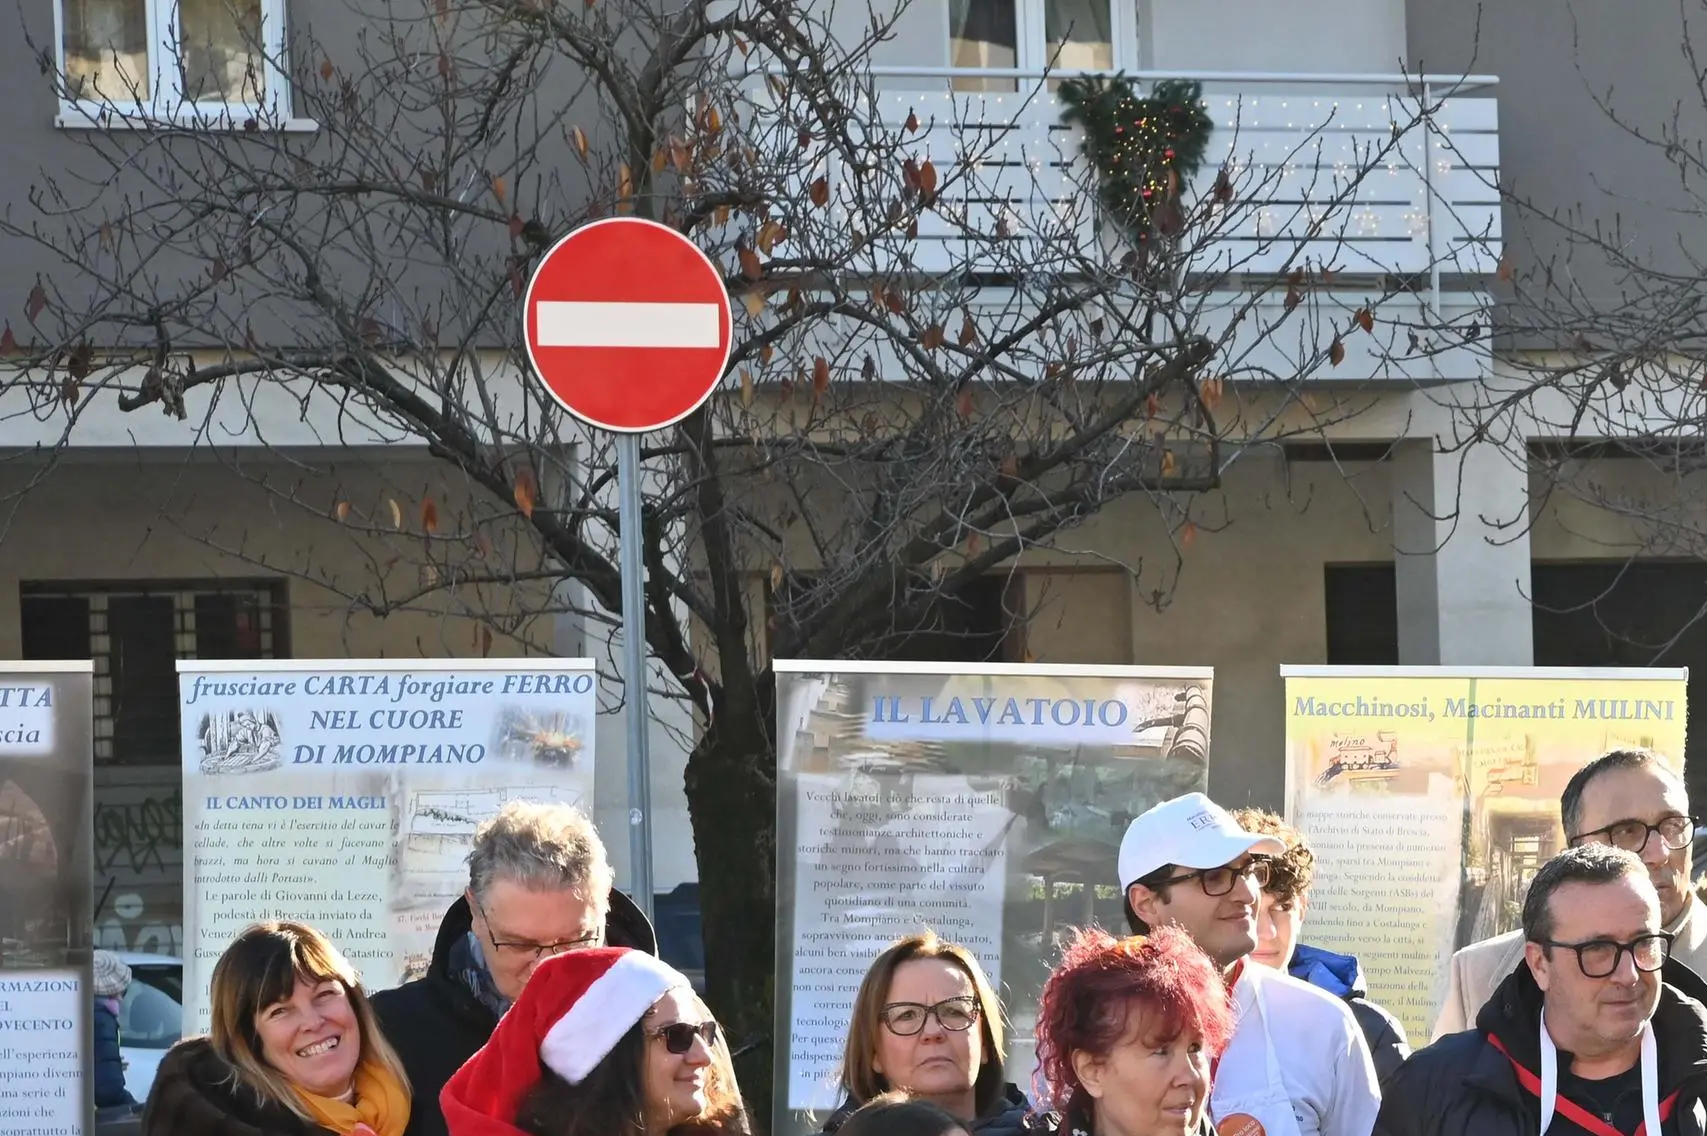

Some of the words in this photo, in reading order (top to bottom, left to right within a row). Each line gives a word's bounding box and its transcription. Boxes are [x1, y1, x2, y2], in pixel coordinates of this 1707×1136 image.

[186, 676, 296, 704] frusciare
[304, 676, 390, 696] CARTA
[391, 676, 493, 704] forgiare
[501, 675, 593, 695] FERRO
[872, 695, 909, 723] IL
[920, 696, 1128, 727] LAVATOIO
[1293, 696, 1435, 721] Macchinosi,
[1442, 697, 1565, 719] Macinanti
[1572, 699, 1674, 721] MULINI
[310, 709, 362, 730] NEL
[369, 709, 464, 730] CUORE
[292, 744, 325, 765] DI
[332, 743, 486, 765] MOMPIANO
[206, 796, 222, 809] IL
[226, 796, 288, 810] CANTO
[292, 796, 323, 810] DEI
[328, 796, 387, 810] MAGLI
[913, 812, 973, 822] considerate
[341, 819, 356, 831] del
[894, 829, 973, 840] architettoniche
[236, 838, 254, 849] che
[261, 838, 286, 849] altre
[293, 838, 319, 849] volte
[338, 837, 385, 852] facevano
[302, 857, 338, 866] cavano
[362, 854, 399, 869] Maglio
[864, 861, 918, 873] fortissimo
[948, 864, 985, 875] cultura
[813, 879, 864, 892] popolare,
[867, 882, 896, 891] come
[899, 881, 926, 893] parte
[929, 879, 946, 891] del
[949, 880, 985, 892] vissuto
[205, 889, 216, 901] Le
[221, 890, 257, 904] parole
[260, 889, 272, 901] di
[275, 889, 327, 902] Giovanni
[330, 889, 344, 902] da
[347, 890, 383, 903] Lezze,
[824, 896, 882, 909] quotidiano
[884, 897, 895, 907] di
[213, 909, 256, 924] podestà
[259, 909, 271, 921] di
[274, 909, 315, 921] Brescia
[318, 910, 357, 921] inviato
[359, 910, 373, 921] da
[821, 913, 841, 924] Tra
[843, 913, 901, 928] Mompiano
[346, 927, 387, 940] Andrea
[801, 931, 872, 944] sopravvivono
[342, 948, 395, 960] Catastico
[827, 947, 847, 959] ben
[0, 1019, 74, 1031] VECENTO
[54, 1086, 66, 1098] di
